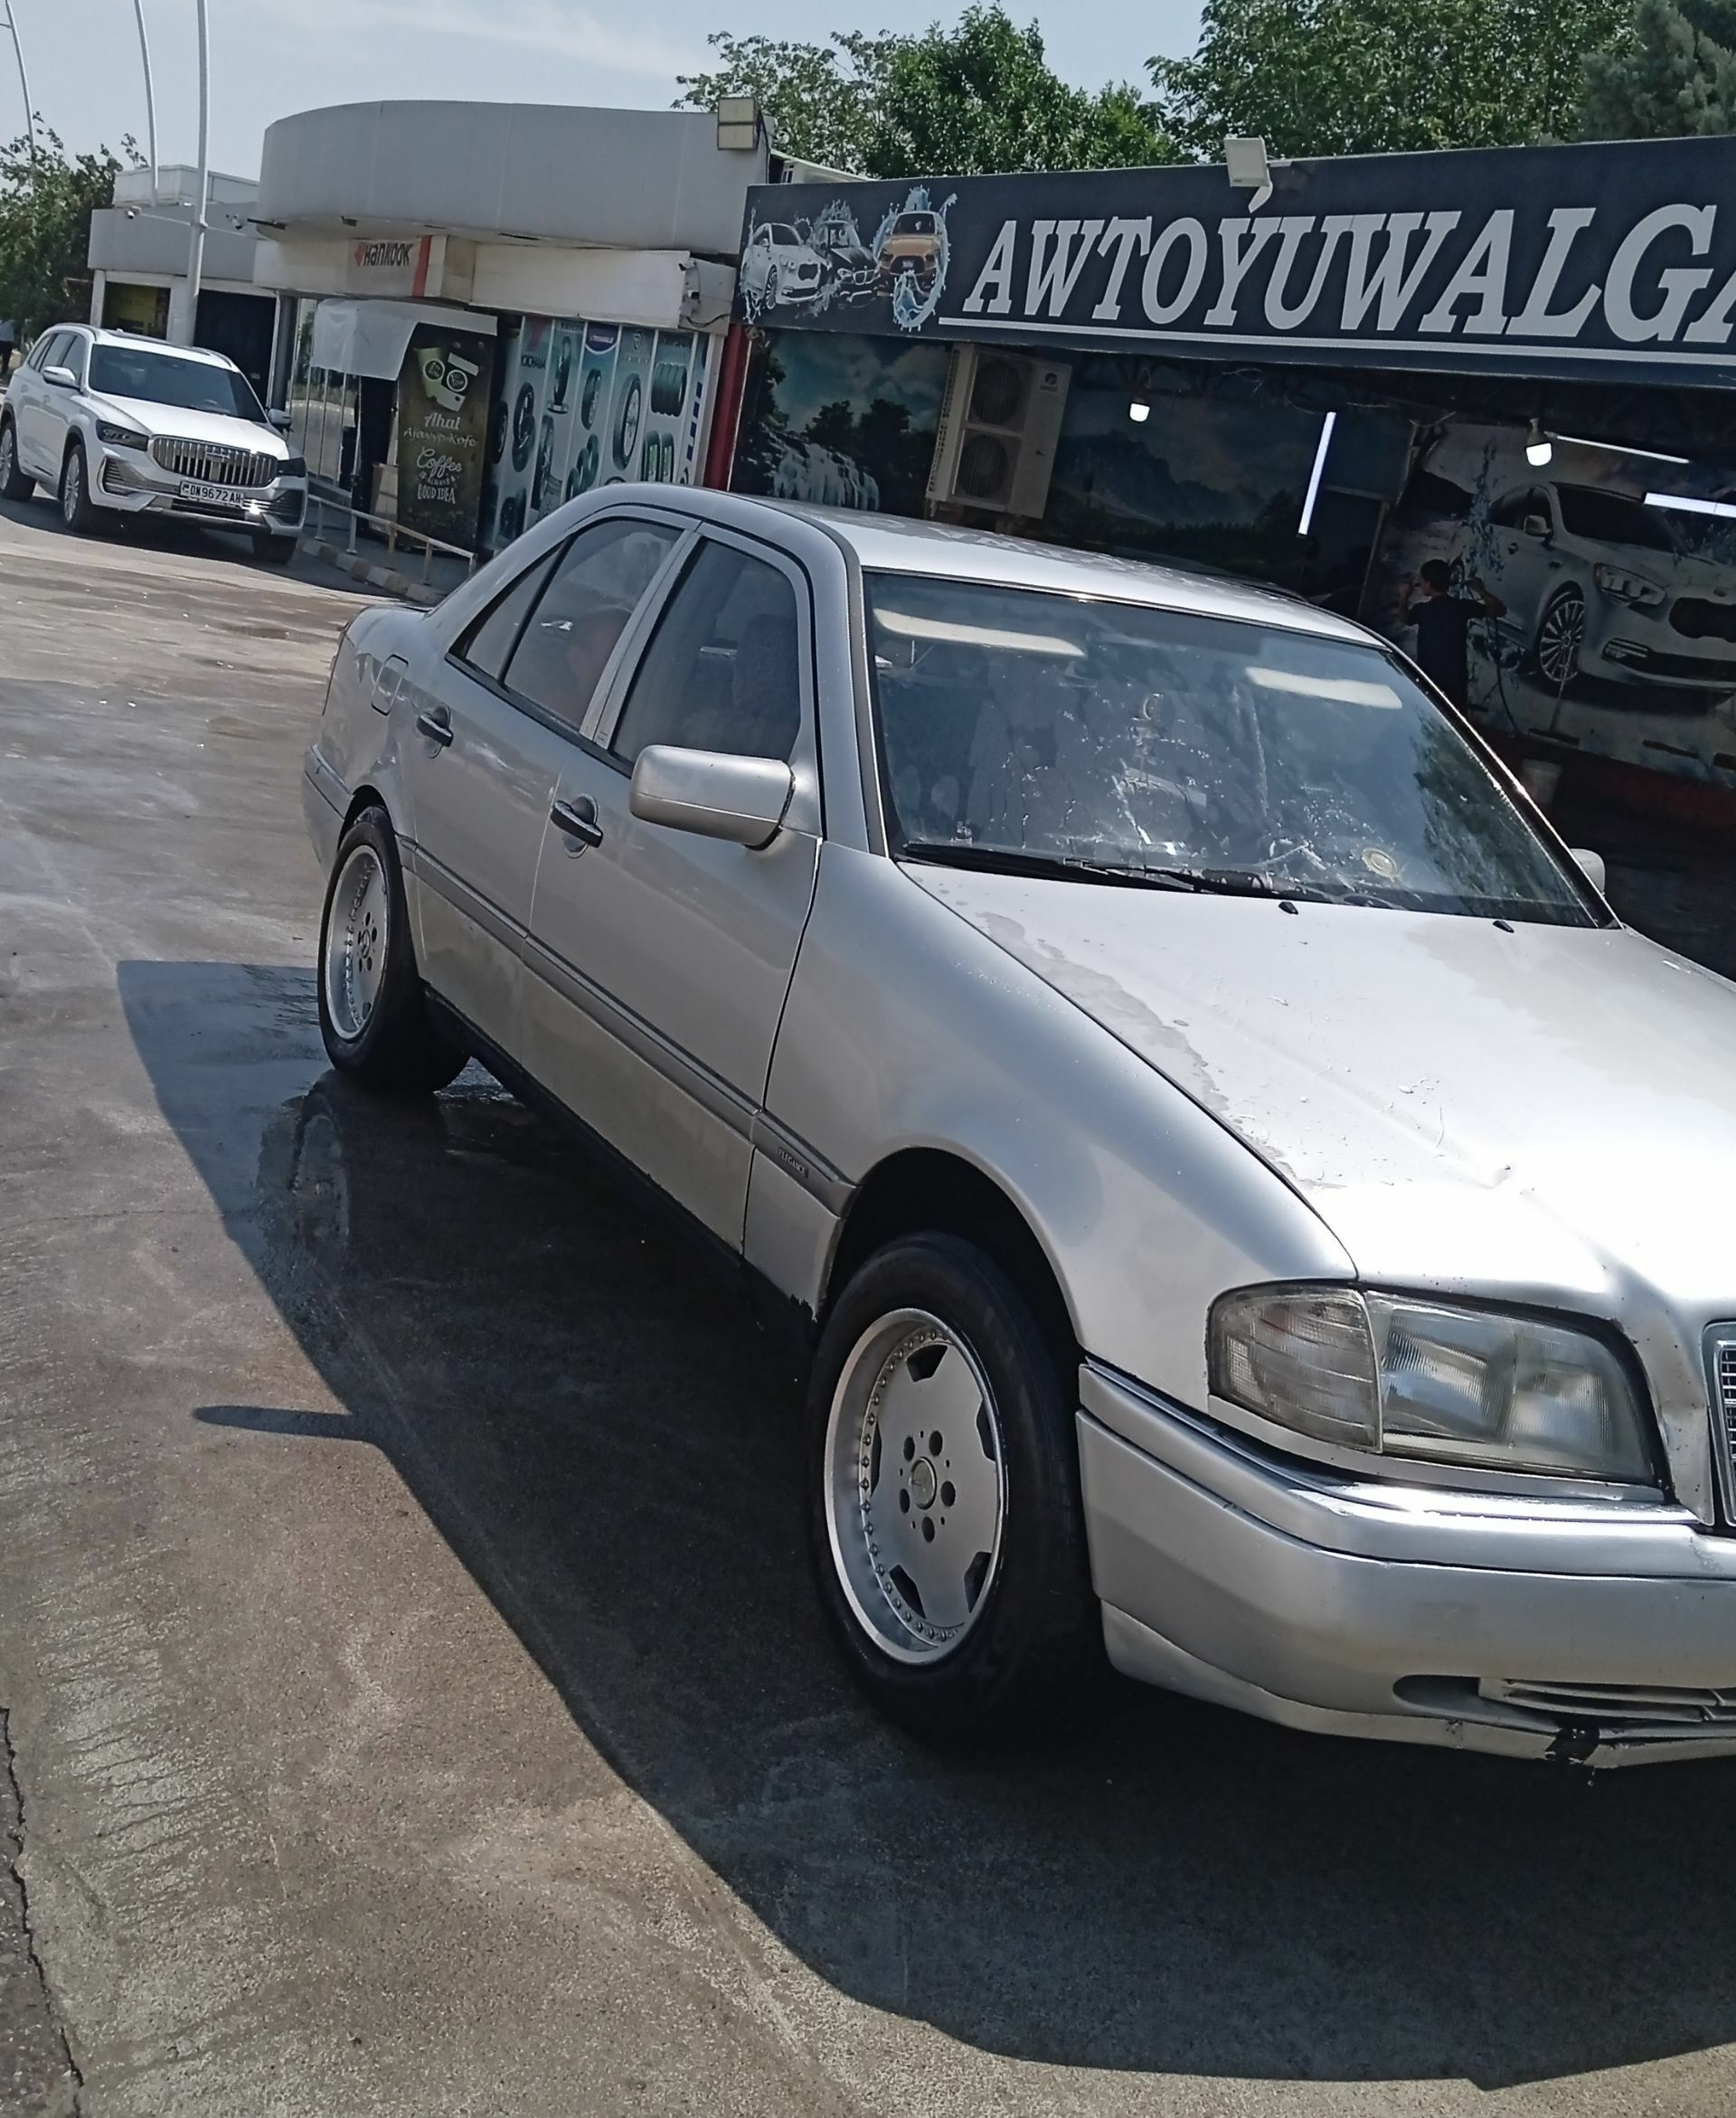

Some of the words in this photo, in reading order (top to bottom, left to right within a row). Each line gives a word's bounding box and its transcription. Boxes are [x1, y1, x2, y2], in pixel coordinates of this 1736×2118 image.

[424, 412, 461, 430] Ahal
[416, 446, 462, 477] Coffee
[437, 487, 456, 504] IDEA
